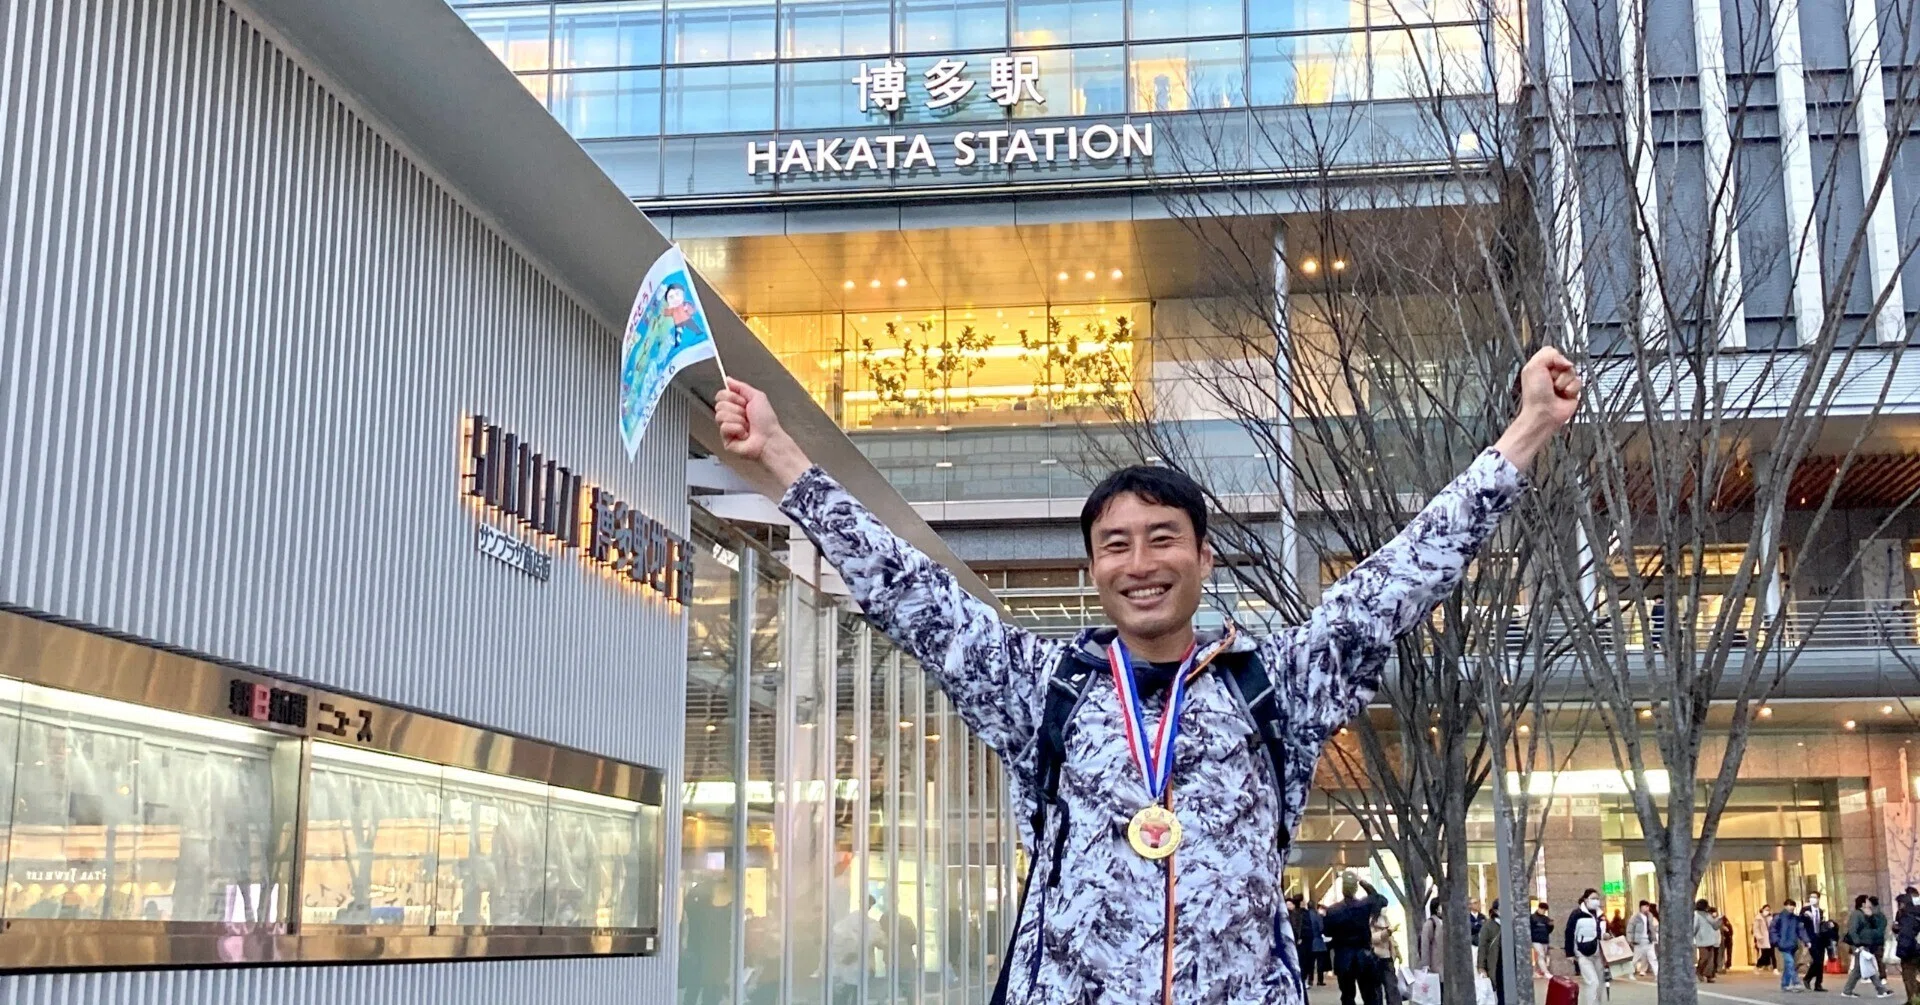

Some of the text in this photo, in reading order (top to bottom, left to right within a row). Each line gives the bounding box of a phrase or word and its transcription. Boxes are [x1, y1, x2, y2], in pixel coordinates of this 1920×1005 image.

[851, 56, 1046, 114] 博多駅
[747, 123, 1154, 176] HAKATA STATION
[317, 702, 373, 742] ニュース
